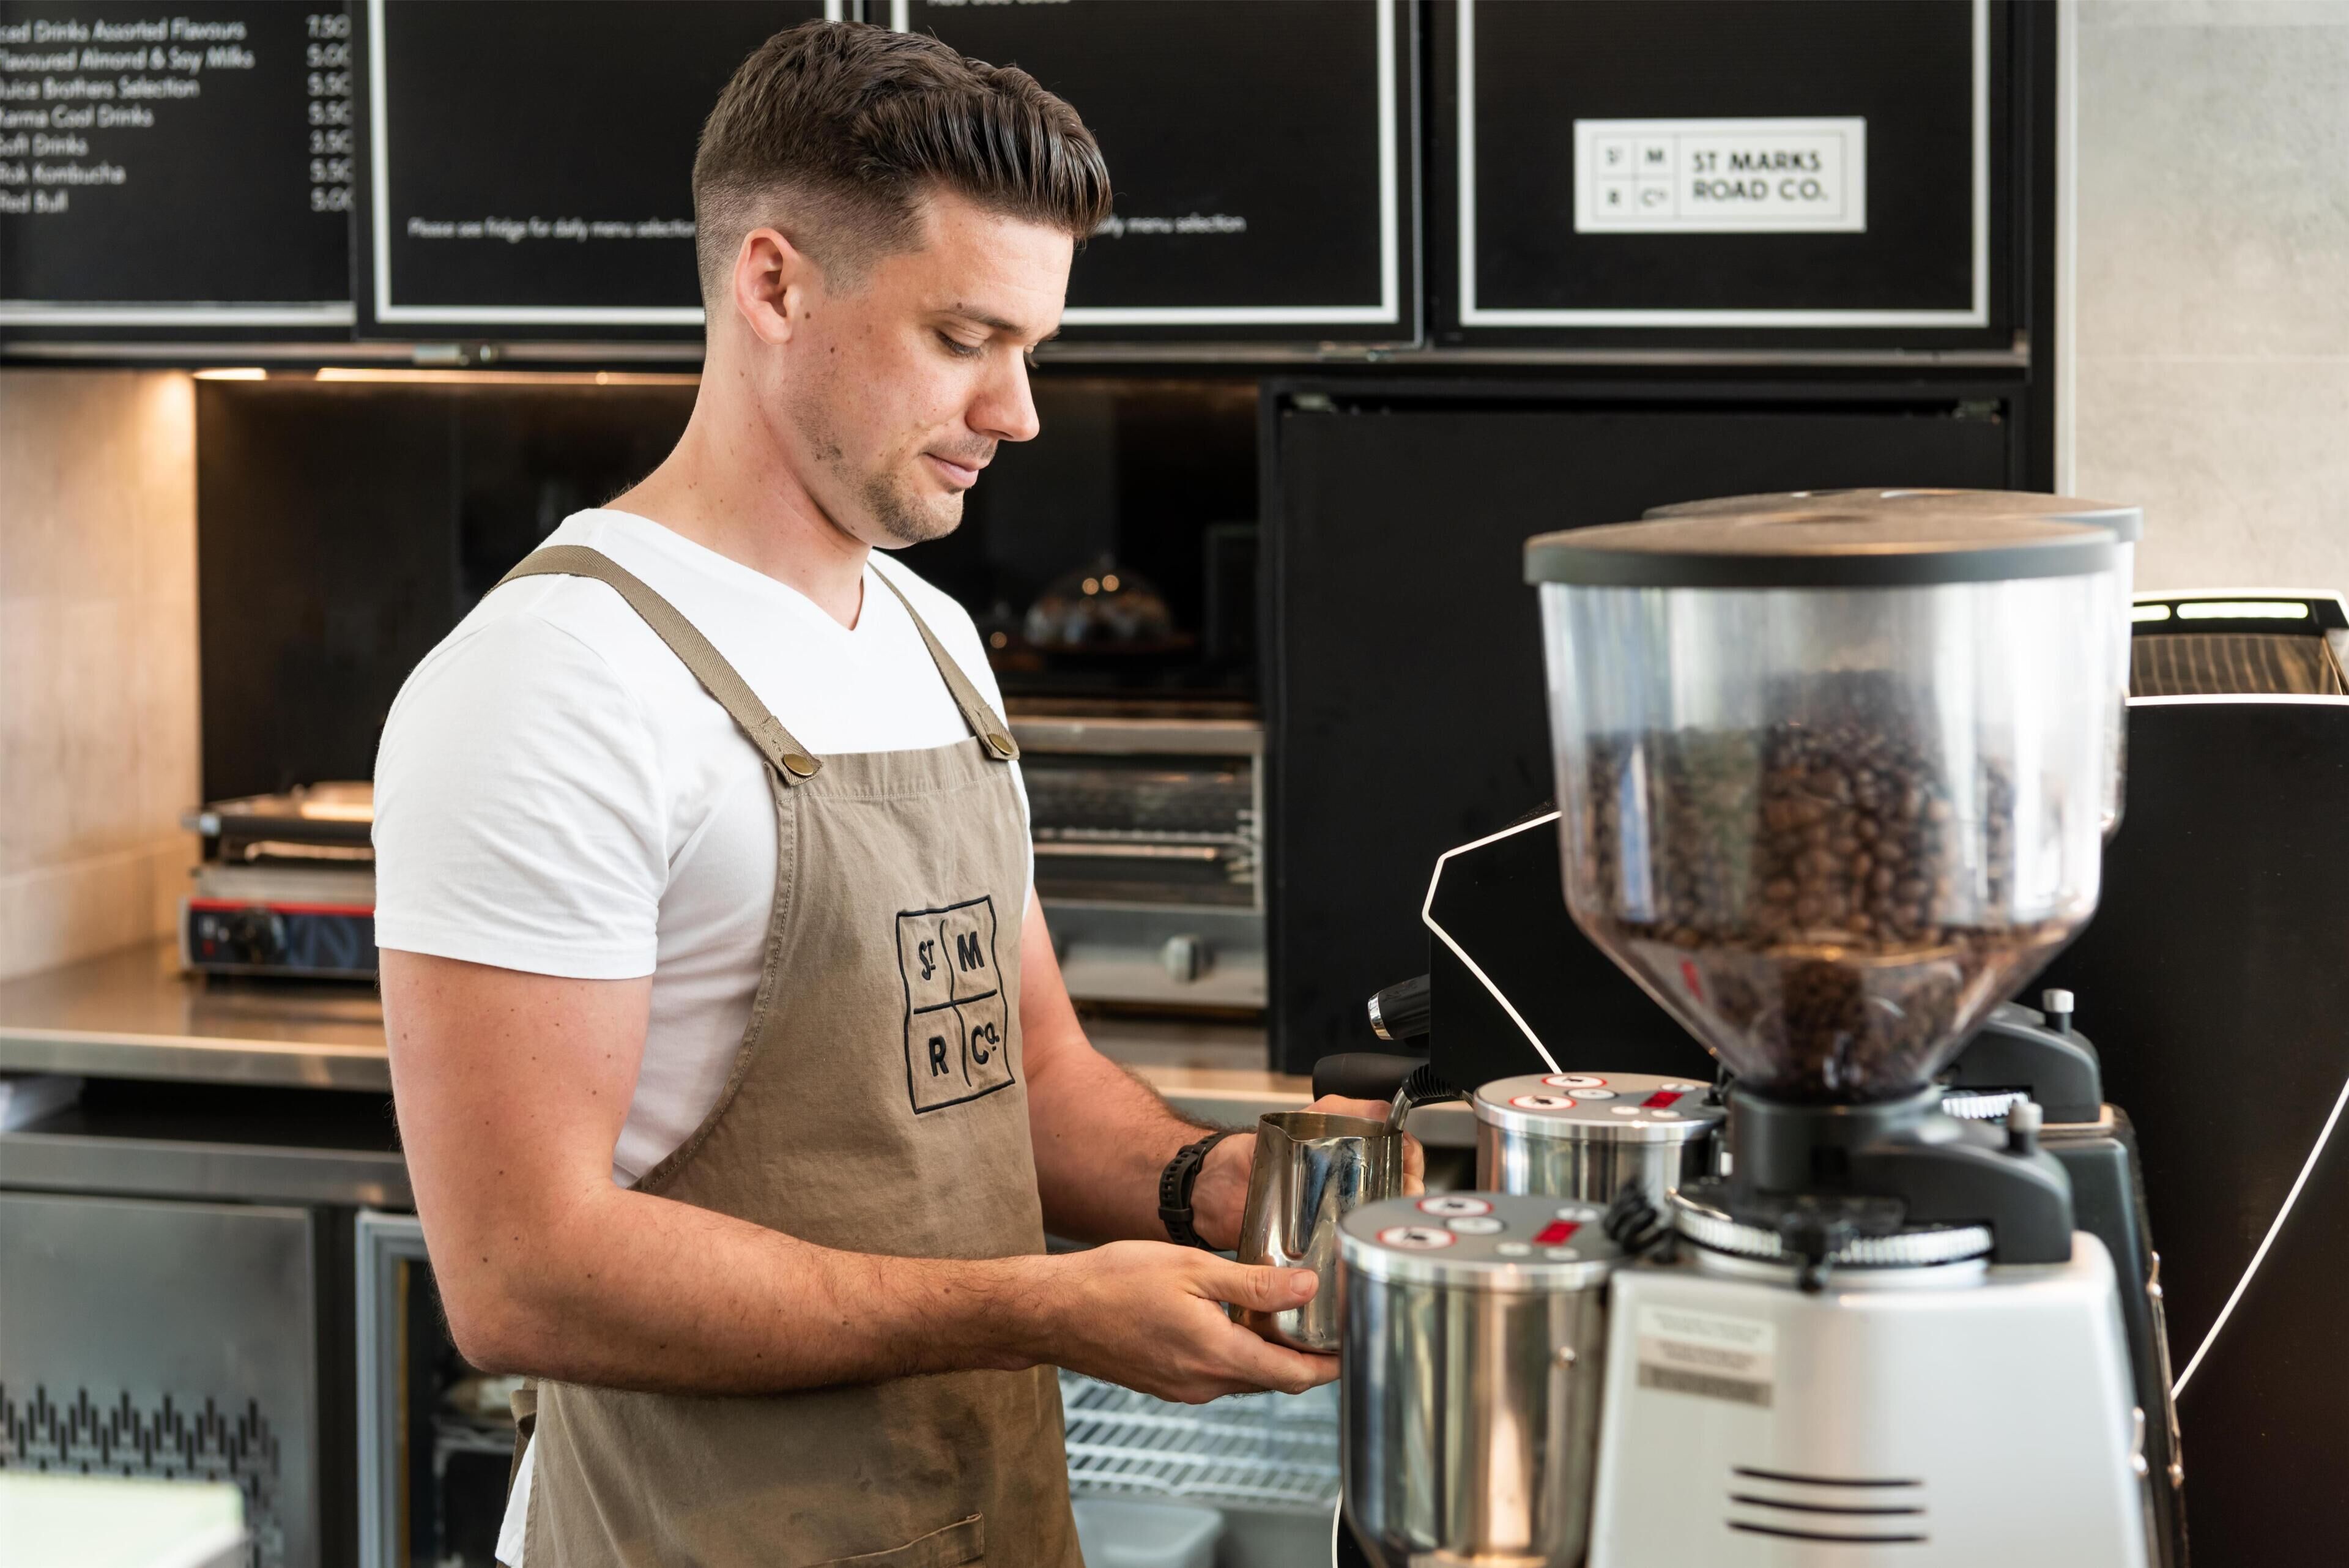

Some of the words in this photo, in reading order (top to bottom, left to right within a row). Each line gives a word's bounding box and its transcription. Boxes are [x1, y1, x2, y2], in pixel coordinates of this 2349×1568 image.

[0, 20, 32, 43] ced
[34, 20, 90, 43] Drinks
[92, 18, 168, 42] Assorted
[170, 17, 247, 40] Flavours
[306, 14, 351, 38] 7.50
[0, 49, 78, 71] lavoured
[79, 48, 147, 70] Almond
[149, 46, 166, 70] &
[168, 46, 203, 74] Soy
[206, 45, 255, 69] Milks
[0, 79, 40, 100] uice
[43, 76, 116, 100] Brothers
[118, 72, 199, 98] Selection
[50, 105, 95, 128] Cool
[97, 104, 154, 128] Drinks
[32, 133, 89, 157] Drinks
[1644, 146, 1666, 165] M
[32, 163, 126, 185] Kombucha
[1693, 151, 1716, 174] ST
[1729, 152, 1820, 172] MARKS
[34, 190, 69, 213] Bull
[1693, 179, 1768, 201] ROAD
[1778, 178, 1828, 202] CO.
[407, 217, 456, 237] Please
[458, 222, 483, 237] see
[484, 217, 527, 243] fridge
[528, 217, 550, 237] for
[551, 217, 588, 240] daily
[590, 221, 633, 237] menu
[635, 218, 696, 237] selectio
[1126, 217, 1172, 233] menu
[1175, 213, 1246, 233] selection
[957, 931, 985, 972] M
[929, 1035, 949, 1077] R
